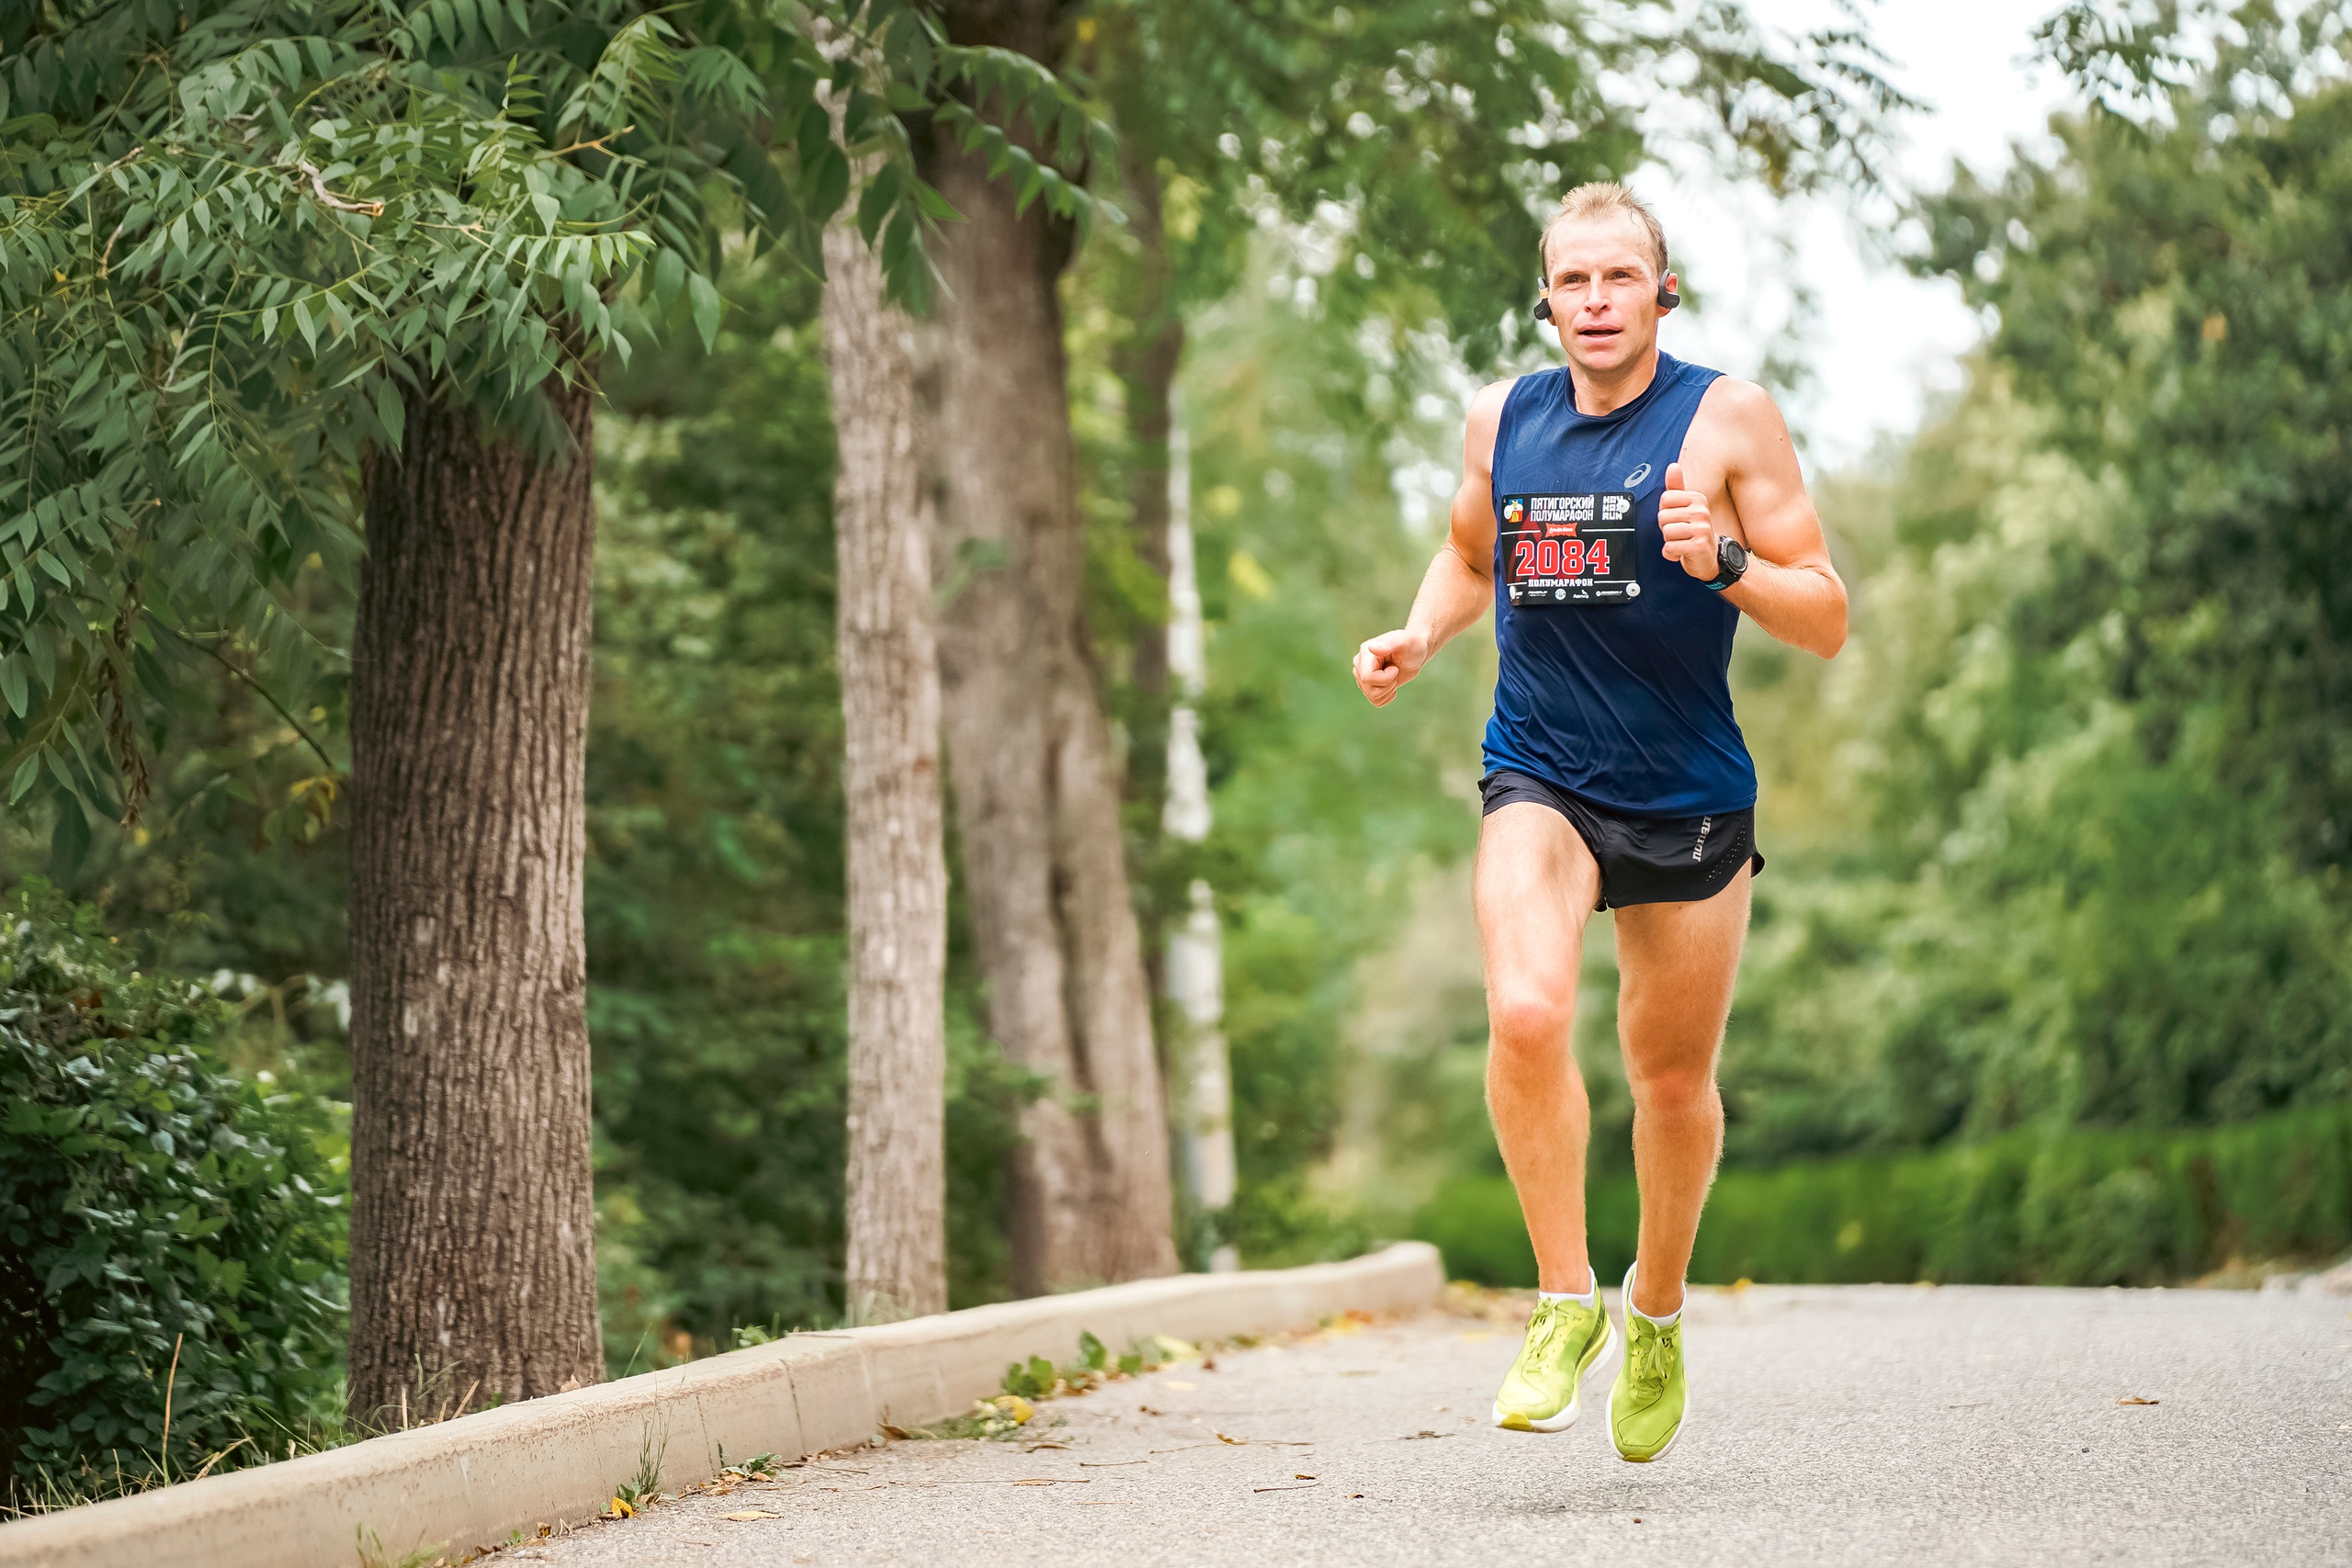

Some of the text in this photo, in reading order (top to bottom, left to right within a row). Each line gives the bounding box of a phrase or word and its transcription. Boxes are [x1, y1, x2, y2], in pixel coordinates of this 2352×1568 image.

[1531, 495, 1594, 509] ПЯТИГОРСКИЙ
[1531, 510, 1593, 521] ПОЛУМАРАФОН
[1516, 539, 1610, 576] 2084
[1528, 579, 1593, 587] ПОЛУМАРАФОН
